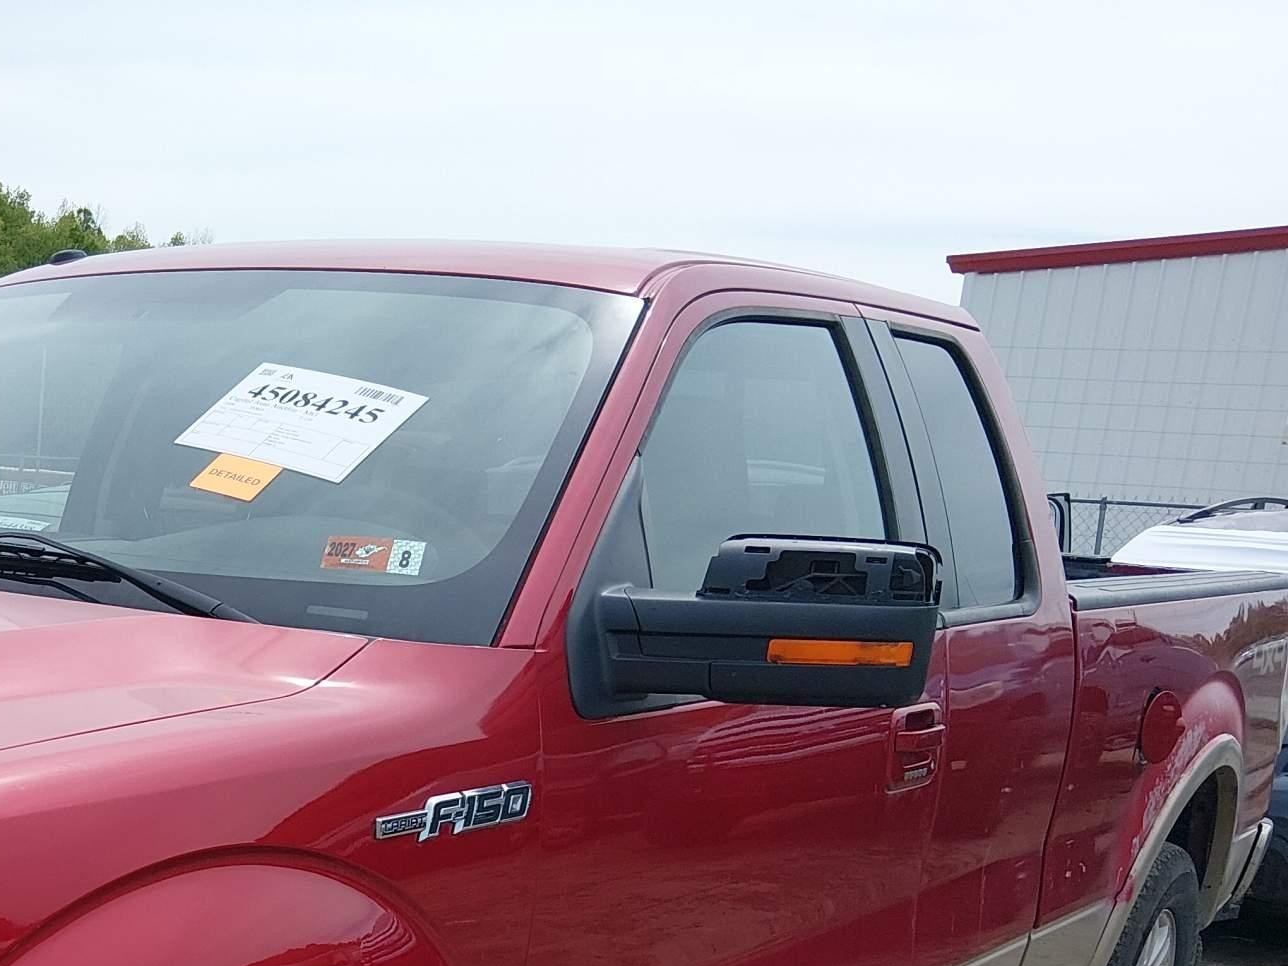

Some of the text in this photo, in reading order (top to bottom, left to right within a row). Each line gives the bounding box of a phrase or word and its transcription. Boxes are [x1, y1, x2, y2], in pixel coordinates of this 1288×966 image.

[247, 383, 386, 425] 45084245
[208, 467, 262, 487] DETAILED
[327, 541, 357, 558] 2027
[398, 550, 412, 569] 8
[383, 813, 427, 834] LARIAT
